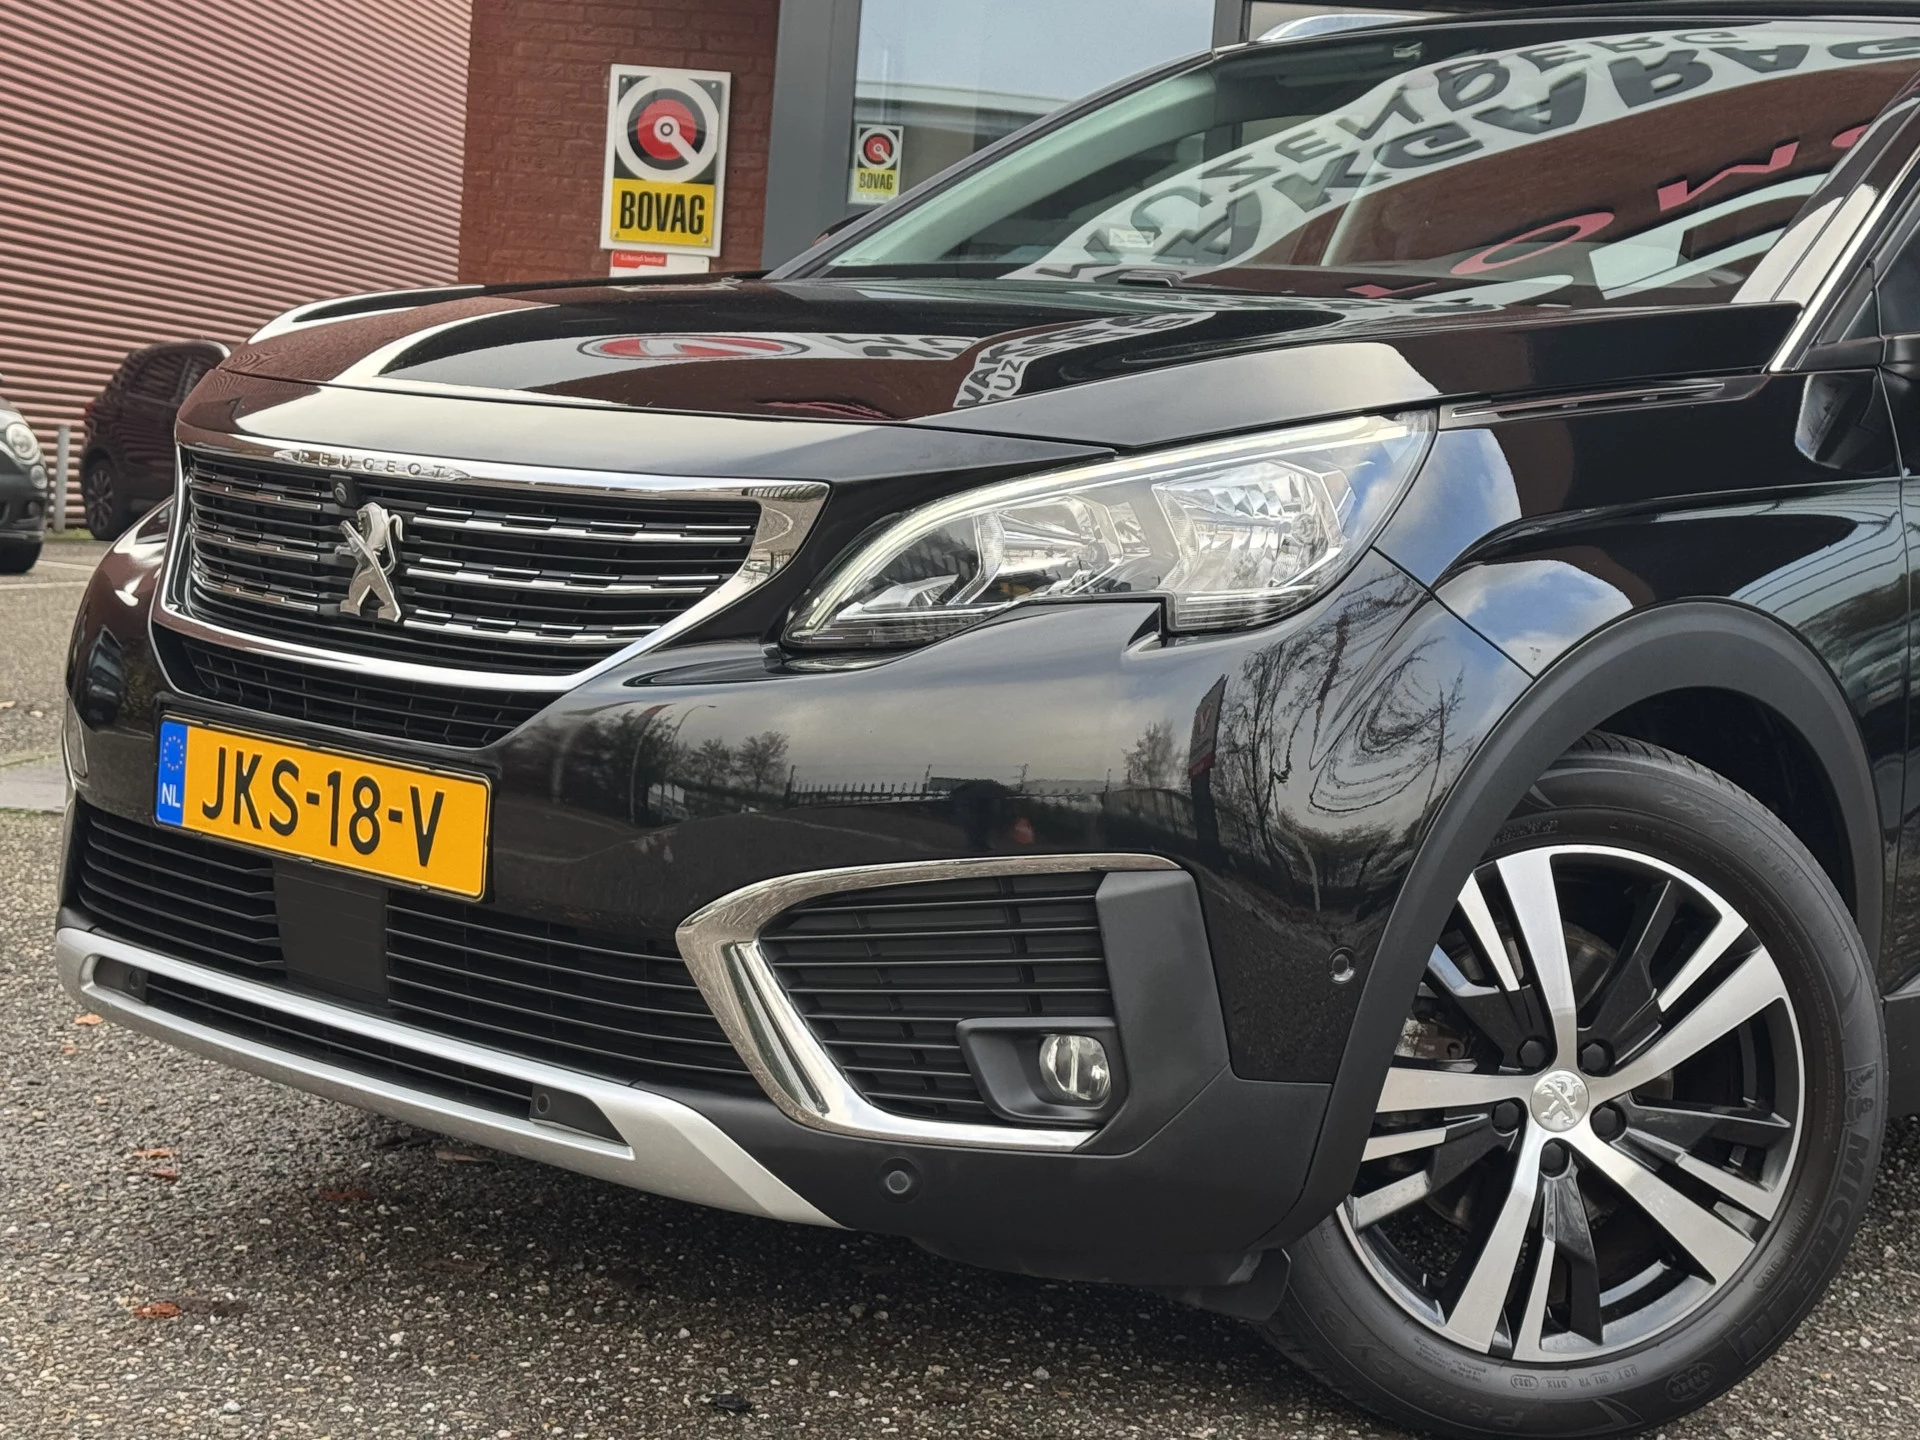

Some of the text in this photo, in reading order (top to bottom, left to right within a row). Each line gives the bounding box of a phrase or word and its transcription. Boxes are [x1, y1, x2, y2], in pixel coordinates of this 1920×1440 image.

[858, 169, 894, 191] BOVAG
[619, 190, 706, 236] BOVAG
[299, 449, 446, 478] PEUGEOT
[161, 782, 181, 808] NL
[202, 745, 445, 868] JKS-18-V
[1739, 1132, 1871, 1359] MICHELIN
